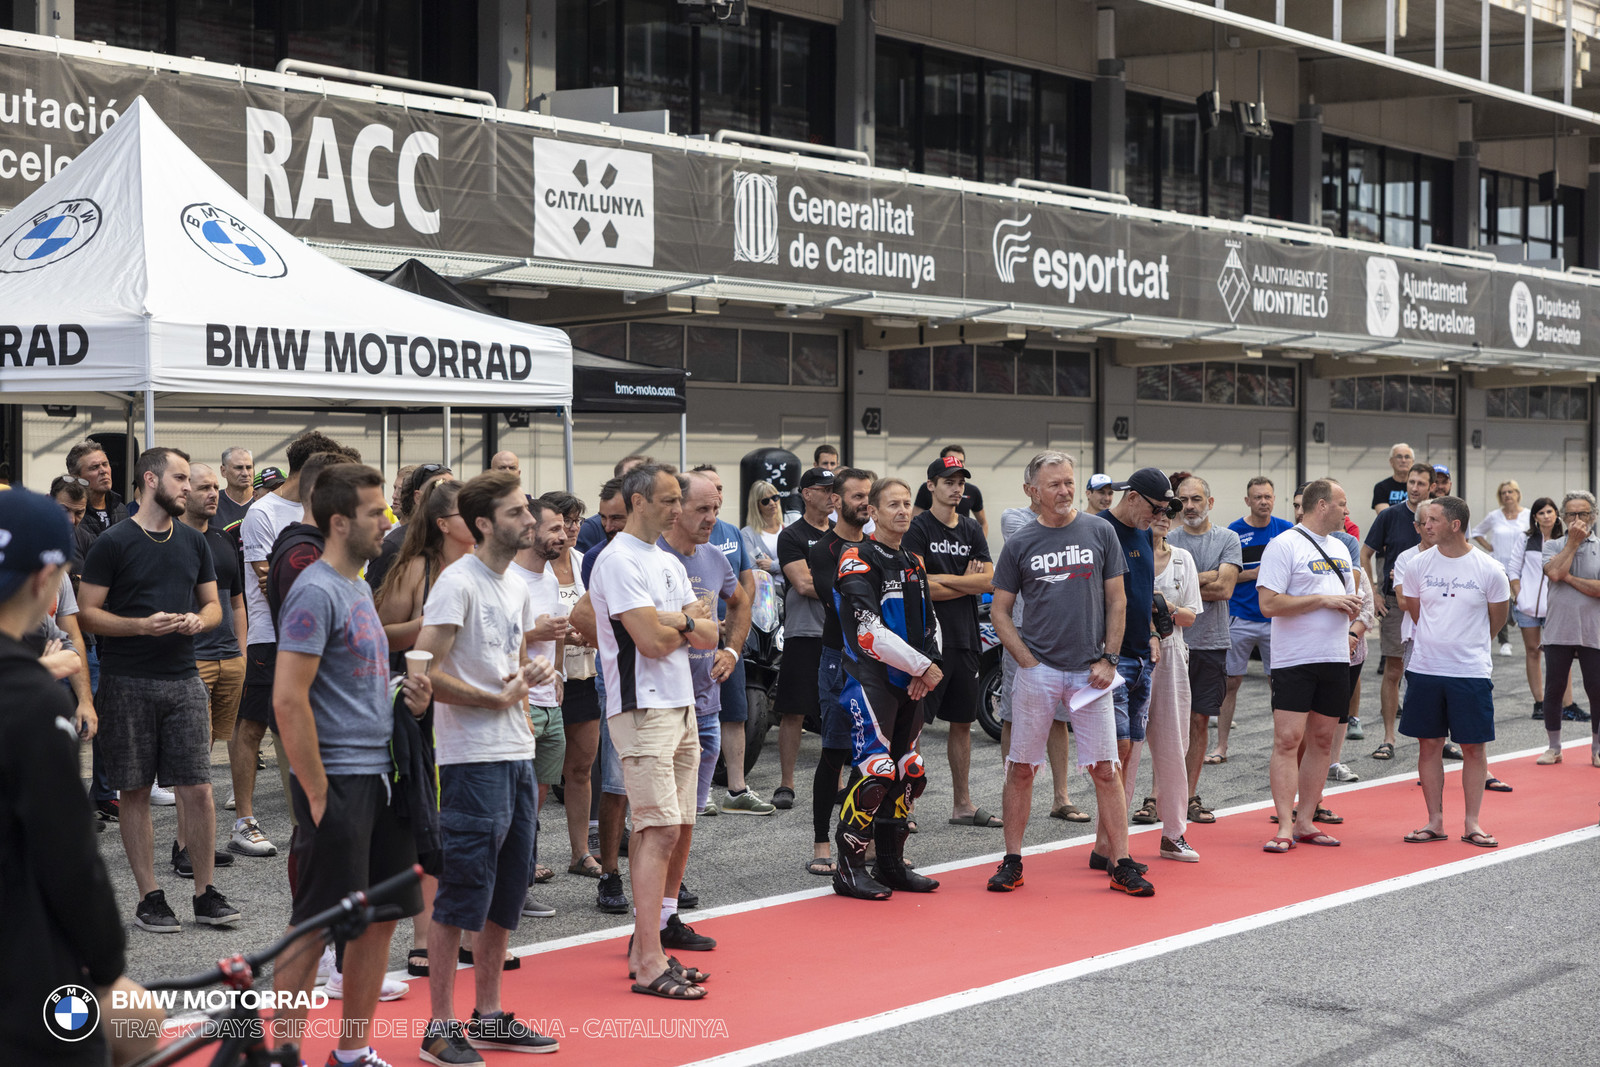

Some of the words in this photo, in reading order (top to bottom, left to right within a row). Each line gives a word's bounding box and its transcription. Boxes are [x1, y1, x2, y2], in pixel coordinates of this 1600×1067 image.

[246, 106, 440, 234] RACC
[33, 203, 96, 226] BMW
[545, 188, 644, 217] CATALUNYA
[788, 186, 914, 236] Generalitat
[187, 207, 246, 231] BMW
[789, 233, 819, 269] de
[825, 236, 935, 288] Catalunya
[1033, 247, 1169, 303] esportcat
[1252, 265, 1313, 289] AJUNTAMENT
[1316, 272, 1328, 290] DE
[1403, 272, 1467, 304] Ajuntament
[1253, 289, 1328, 318] MONTMELÓ
[1536, 294, 1581, 322] Diputació
[1403, 305, 1417, 330] de
[1419, 307, 1475, 335] Barcelona
[1536, 322, 1581, 345] Barcelona
[0, 324, 89, 367] RAD
[206, 324, 310, 371] BMW
[325, 331, 532, 381] MOTORRAD
[615, 382, 675, 397] bmc-moto.com
[866, 412, 880, 430] 23
[1030, 545, 1094, 573] aprilia
